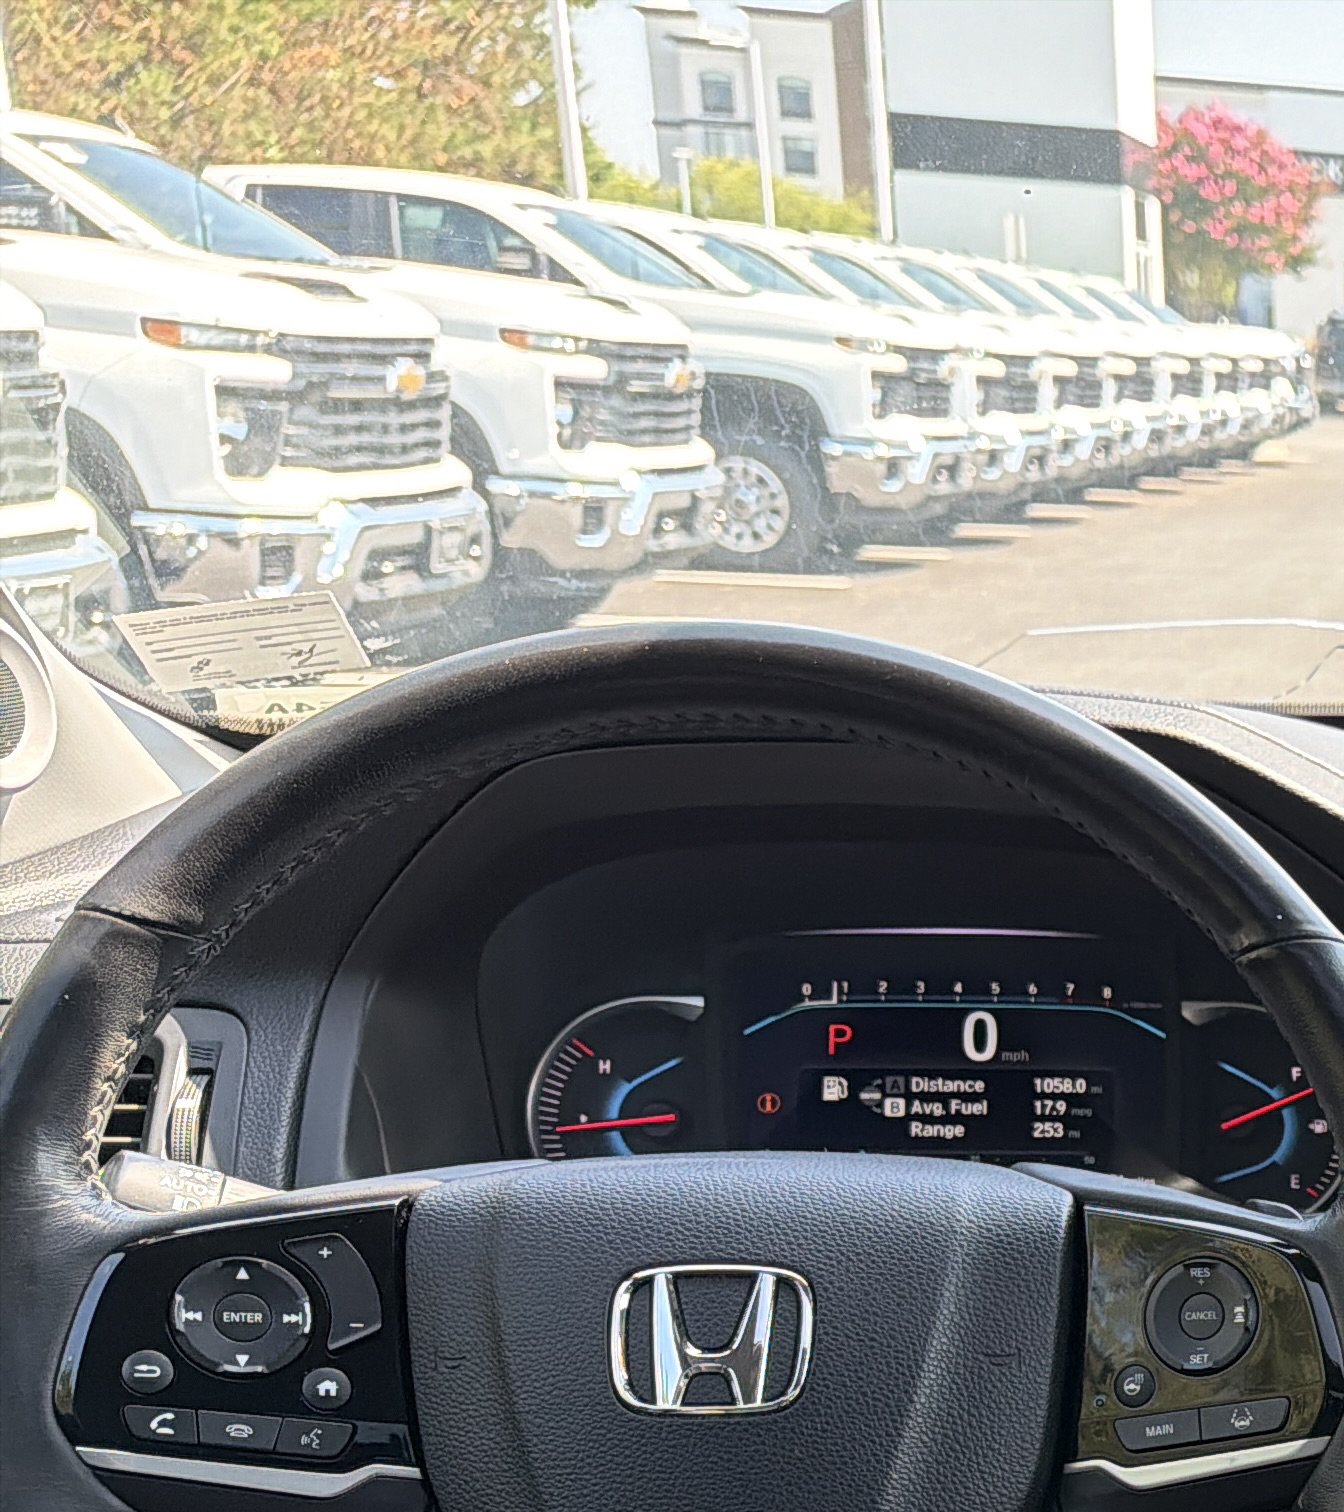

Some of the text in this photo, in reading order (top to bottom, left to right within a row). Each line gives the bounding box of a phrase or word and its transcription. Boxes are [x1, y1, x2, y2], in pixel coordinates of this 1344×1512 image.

[801, 982, 813, 995] 0
[878, 980, 888, 993] 2
[915, 980, 925, 993] 3
[953, 981, 963, 994] 4
[990, 981, 1000, 994] 5
[1028, 982, 1038, 995] 6
[1065, 982, 1075, 996] 7
[1102, 985, 1112, 999] 8
[828, 1024, 852, 1055] P
[963, 1011, 1029, 1063] 0 mph
[599, 1059, 611, 1074] H
[1291, 1066, 1302, 1082] F
[911, 1076, 985, 1093] Distance
[1033, 1077, 1087, 1093] 1058.0
[911, 1101, 946, 1116] Avg.
[951, 1100, 988, 1115] Fuel
[1033, 1101, 1066, 1115] 17.9
[911, 1123, 965, 1139] Range
[1032, 1123, 1064, 1138] 253
[1290, 1174, 1300, 1189] E
[1190, 1267, 1211, 1278] RES
[223, 1312, 263, 1323] ENTER
[1185, 1311, 1218, 1321] CANCEL
[1189, 1354, 1209, 1365] SET
[1146, 1424, 1173, 1436] MAIN
